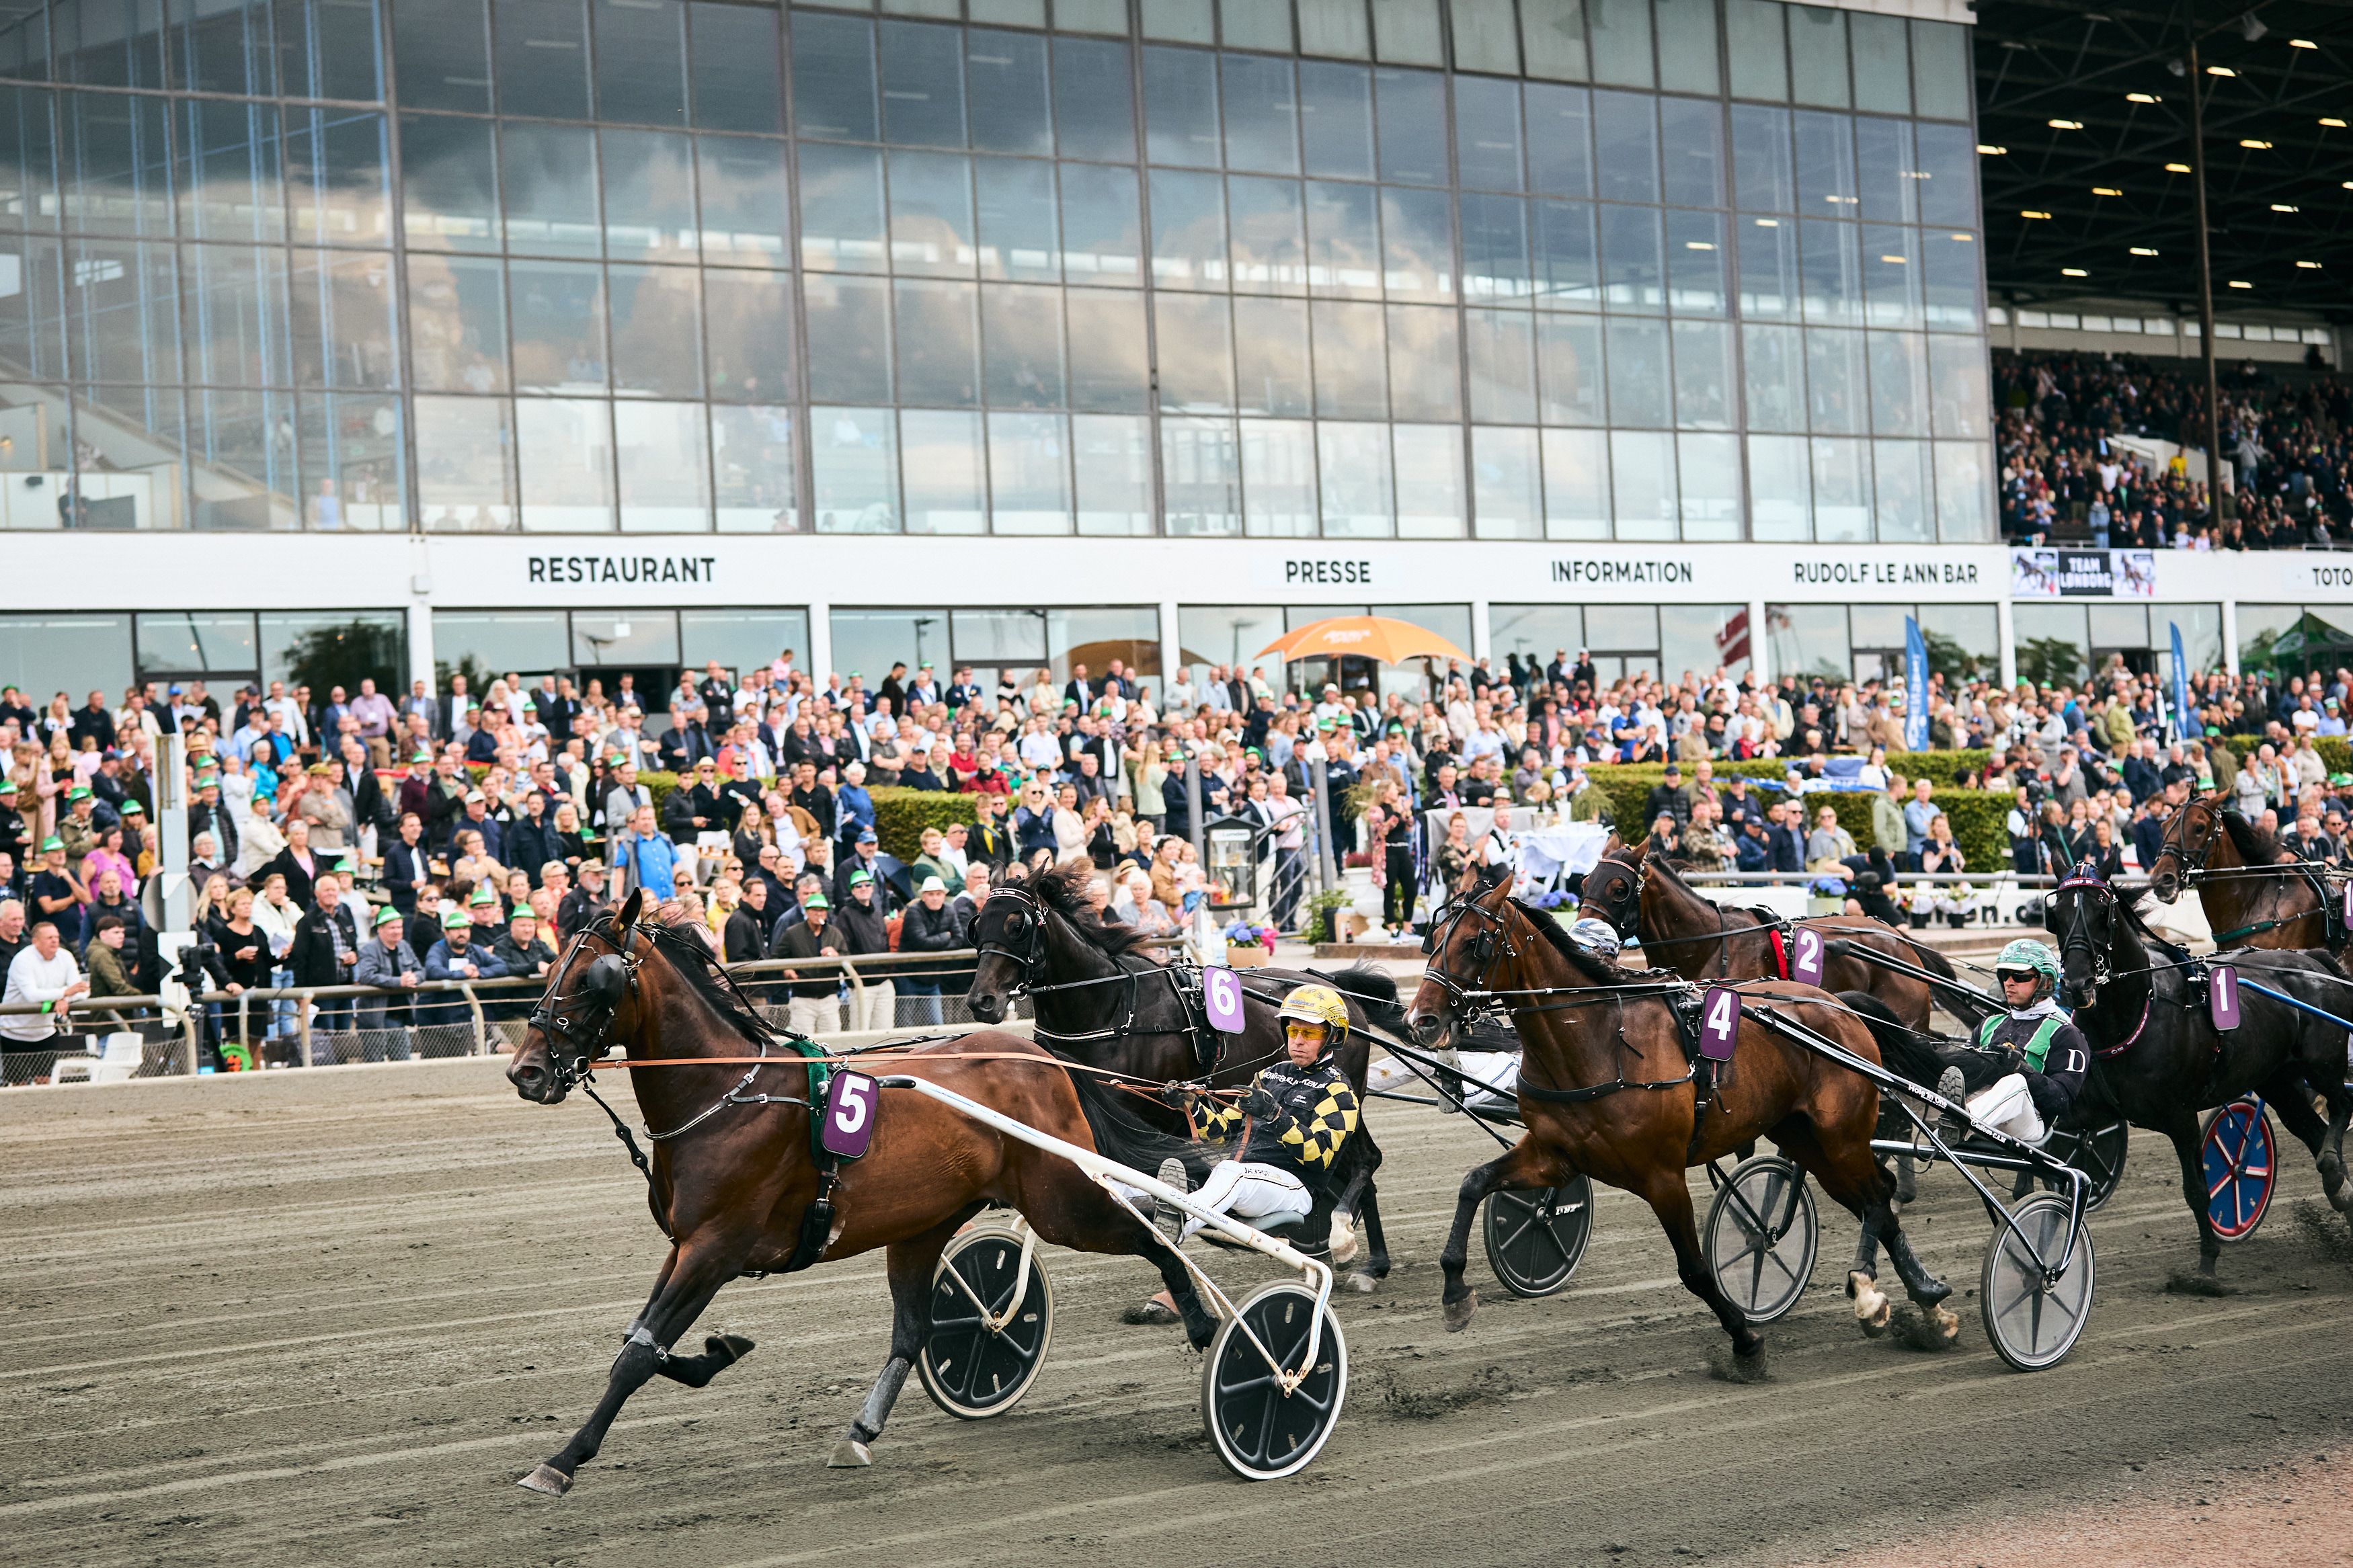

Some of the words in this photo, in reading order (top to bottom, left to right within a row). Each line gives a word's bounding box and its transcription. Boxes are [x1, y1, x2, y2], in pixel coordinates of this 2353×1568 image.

[528, 556, 715, 583] RESTAURANT
[1285, 561, 1371, 583] PRESSE
[1552, 561, 1692, 583] INFORMATION
[1794, 563, 1869, 583] RUDOLF
[1876, 563, 1897, 583] LE
[1903, 564, 1938, 583] ANN
[1944, 564, 1977, 583] BAR
[2068, 557, 2101, 573] TEAM
[2312, 568, 2353, 585] TOTO
[2344, 880, 2353, 917] 1
[1798, 930, 1819, 974] 2
[1211, 970, 1236, 1016] 6
[2216, 968, 2229, 1012] 1
[1708, 991, 1732, 1041] 4
[2065, 1048, 2086, 1073] D
[835, 1074, 871, 1134] 5
[1908, 1083, 1926, 1097] Hole
[1934, 1096, 1948, 1108] One
[1169, 1189, 1207, 1213] CUSTOM
[1205, 1210, 1229, 1225] MULTICAM
